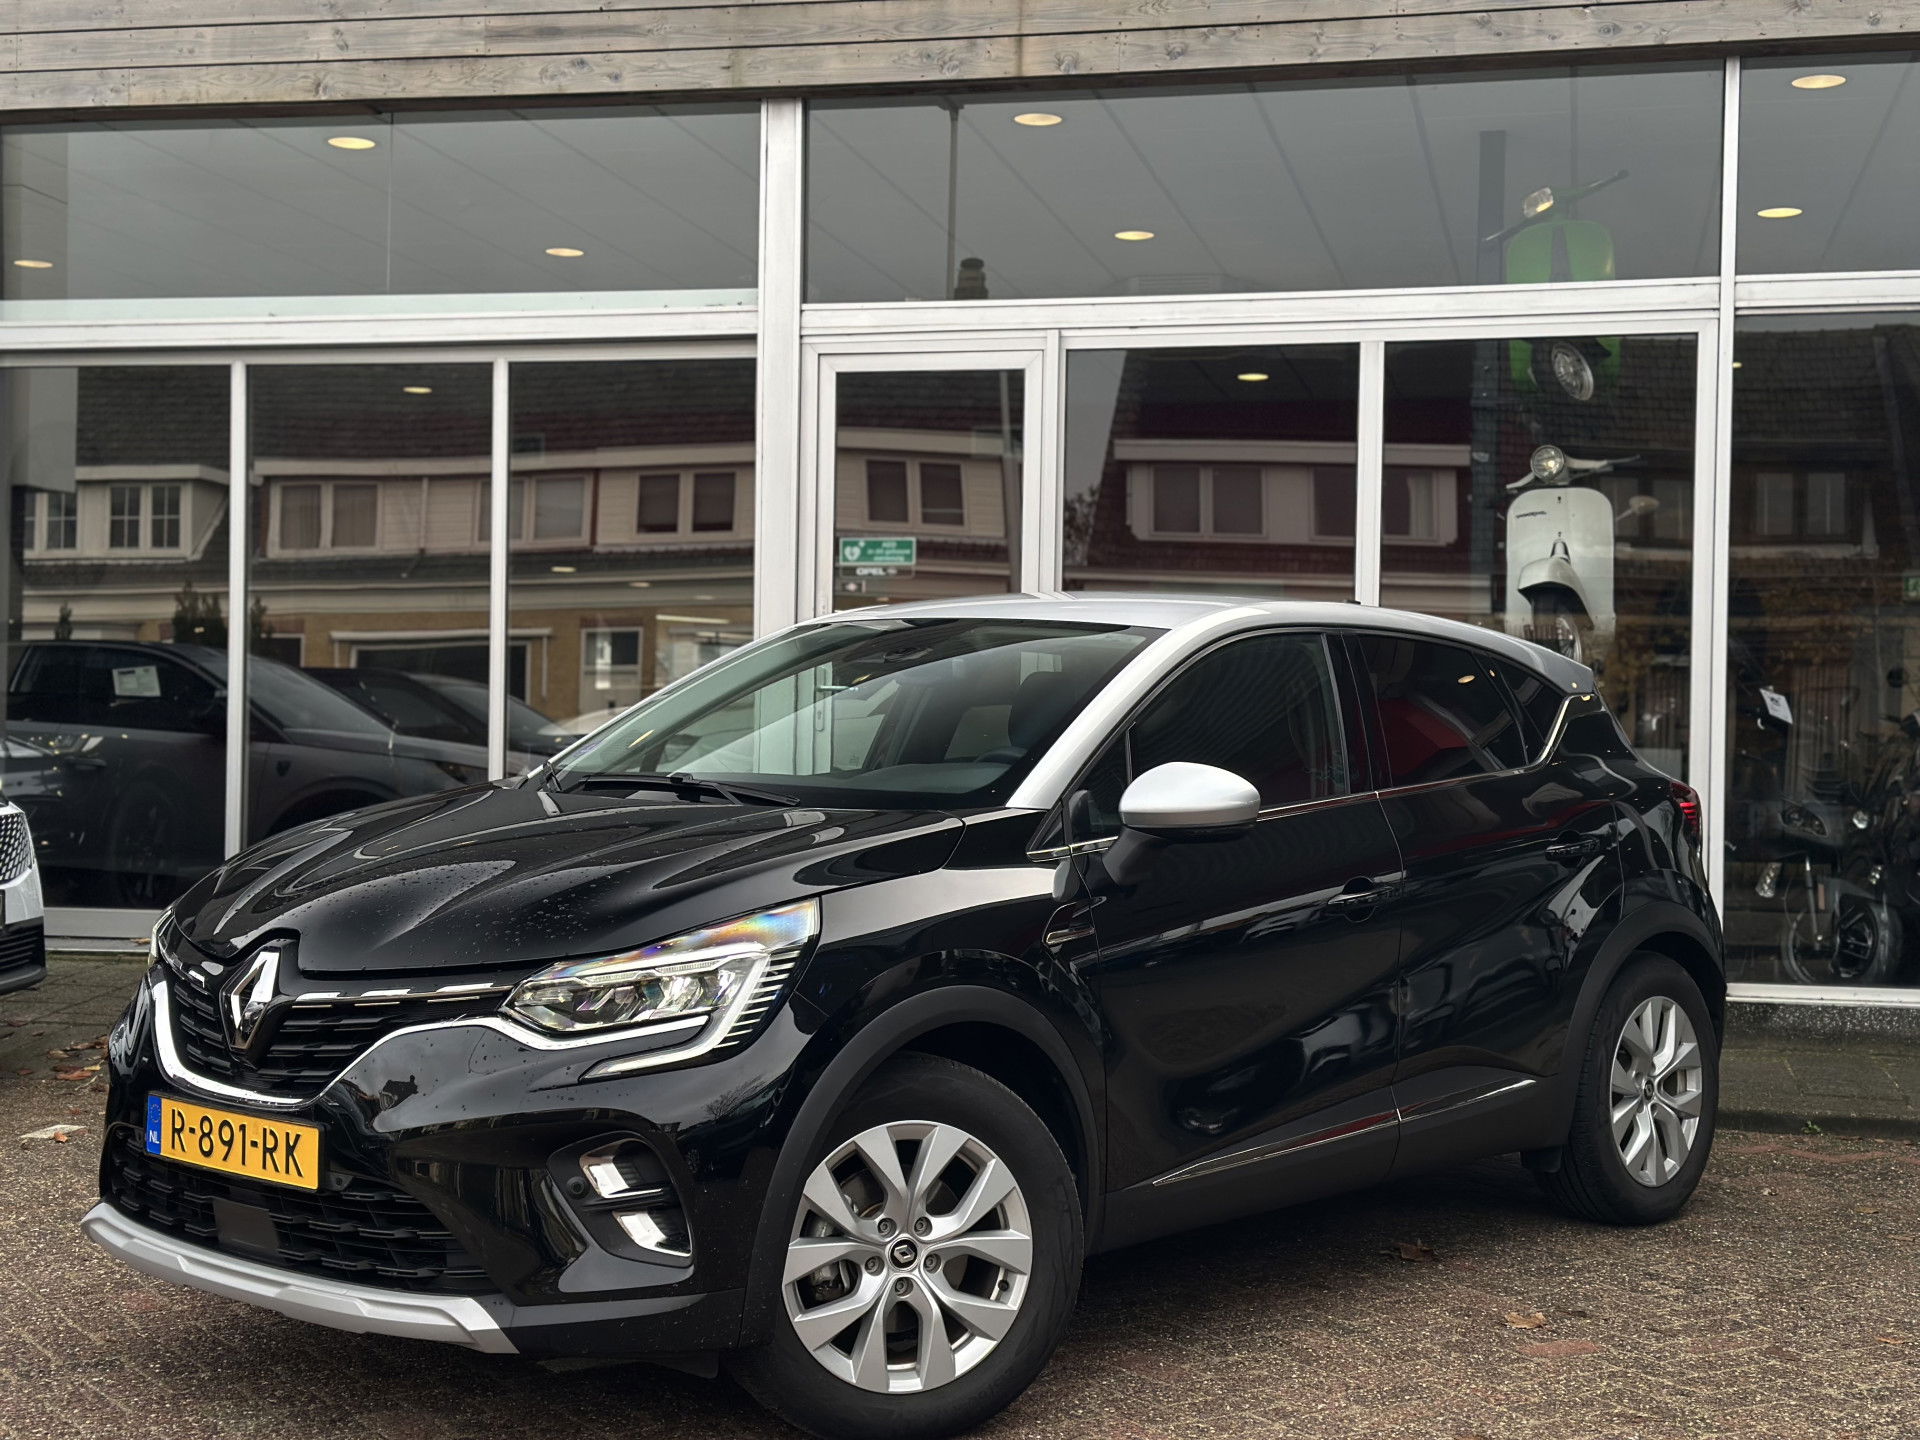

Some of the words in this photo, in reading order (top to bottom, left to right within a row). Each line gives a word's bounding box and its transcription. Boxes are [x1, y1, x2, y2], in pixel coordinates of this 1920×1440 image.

[856, 567, 887, 576] OPEL
[149, 1130, 160, 1145] NL
[171, 1108, 304, 1178] R-891-RK
